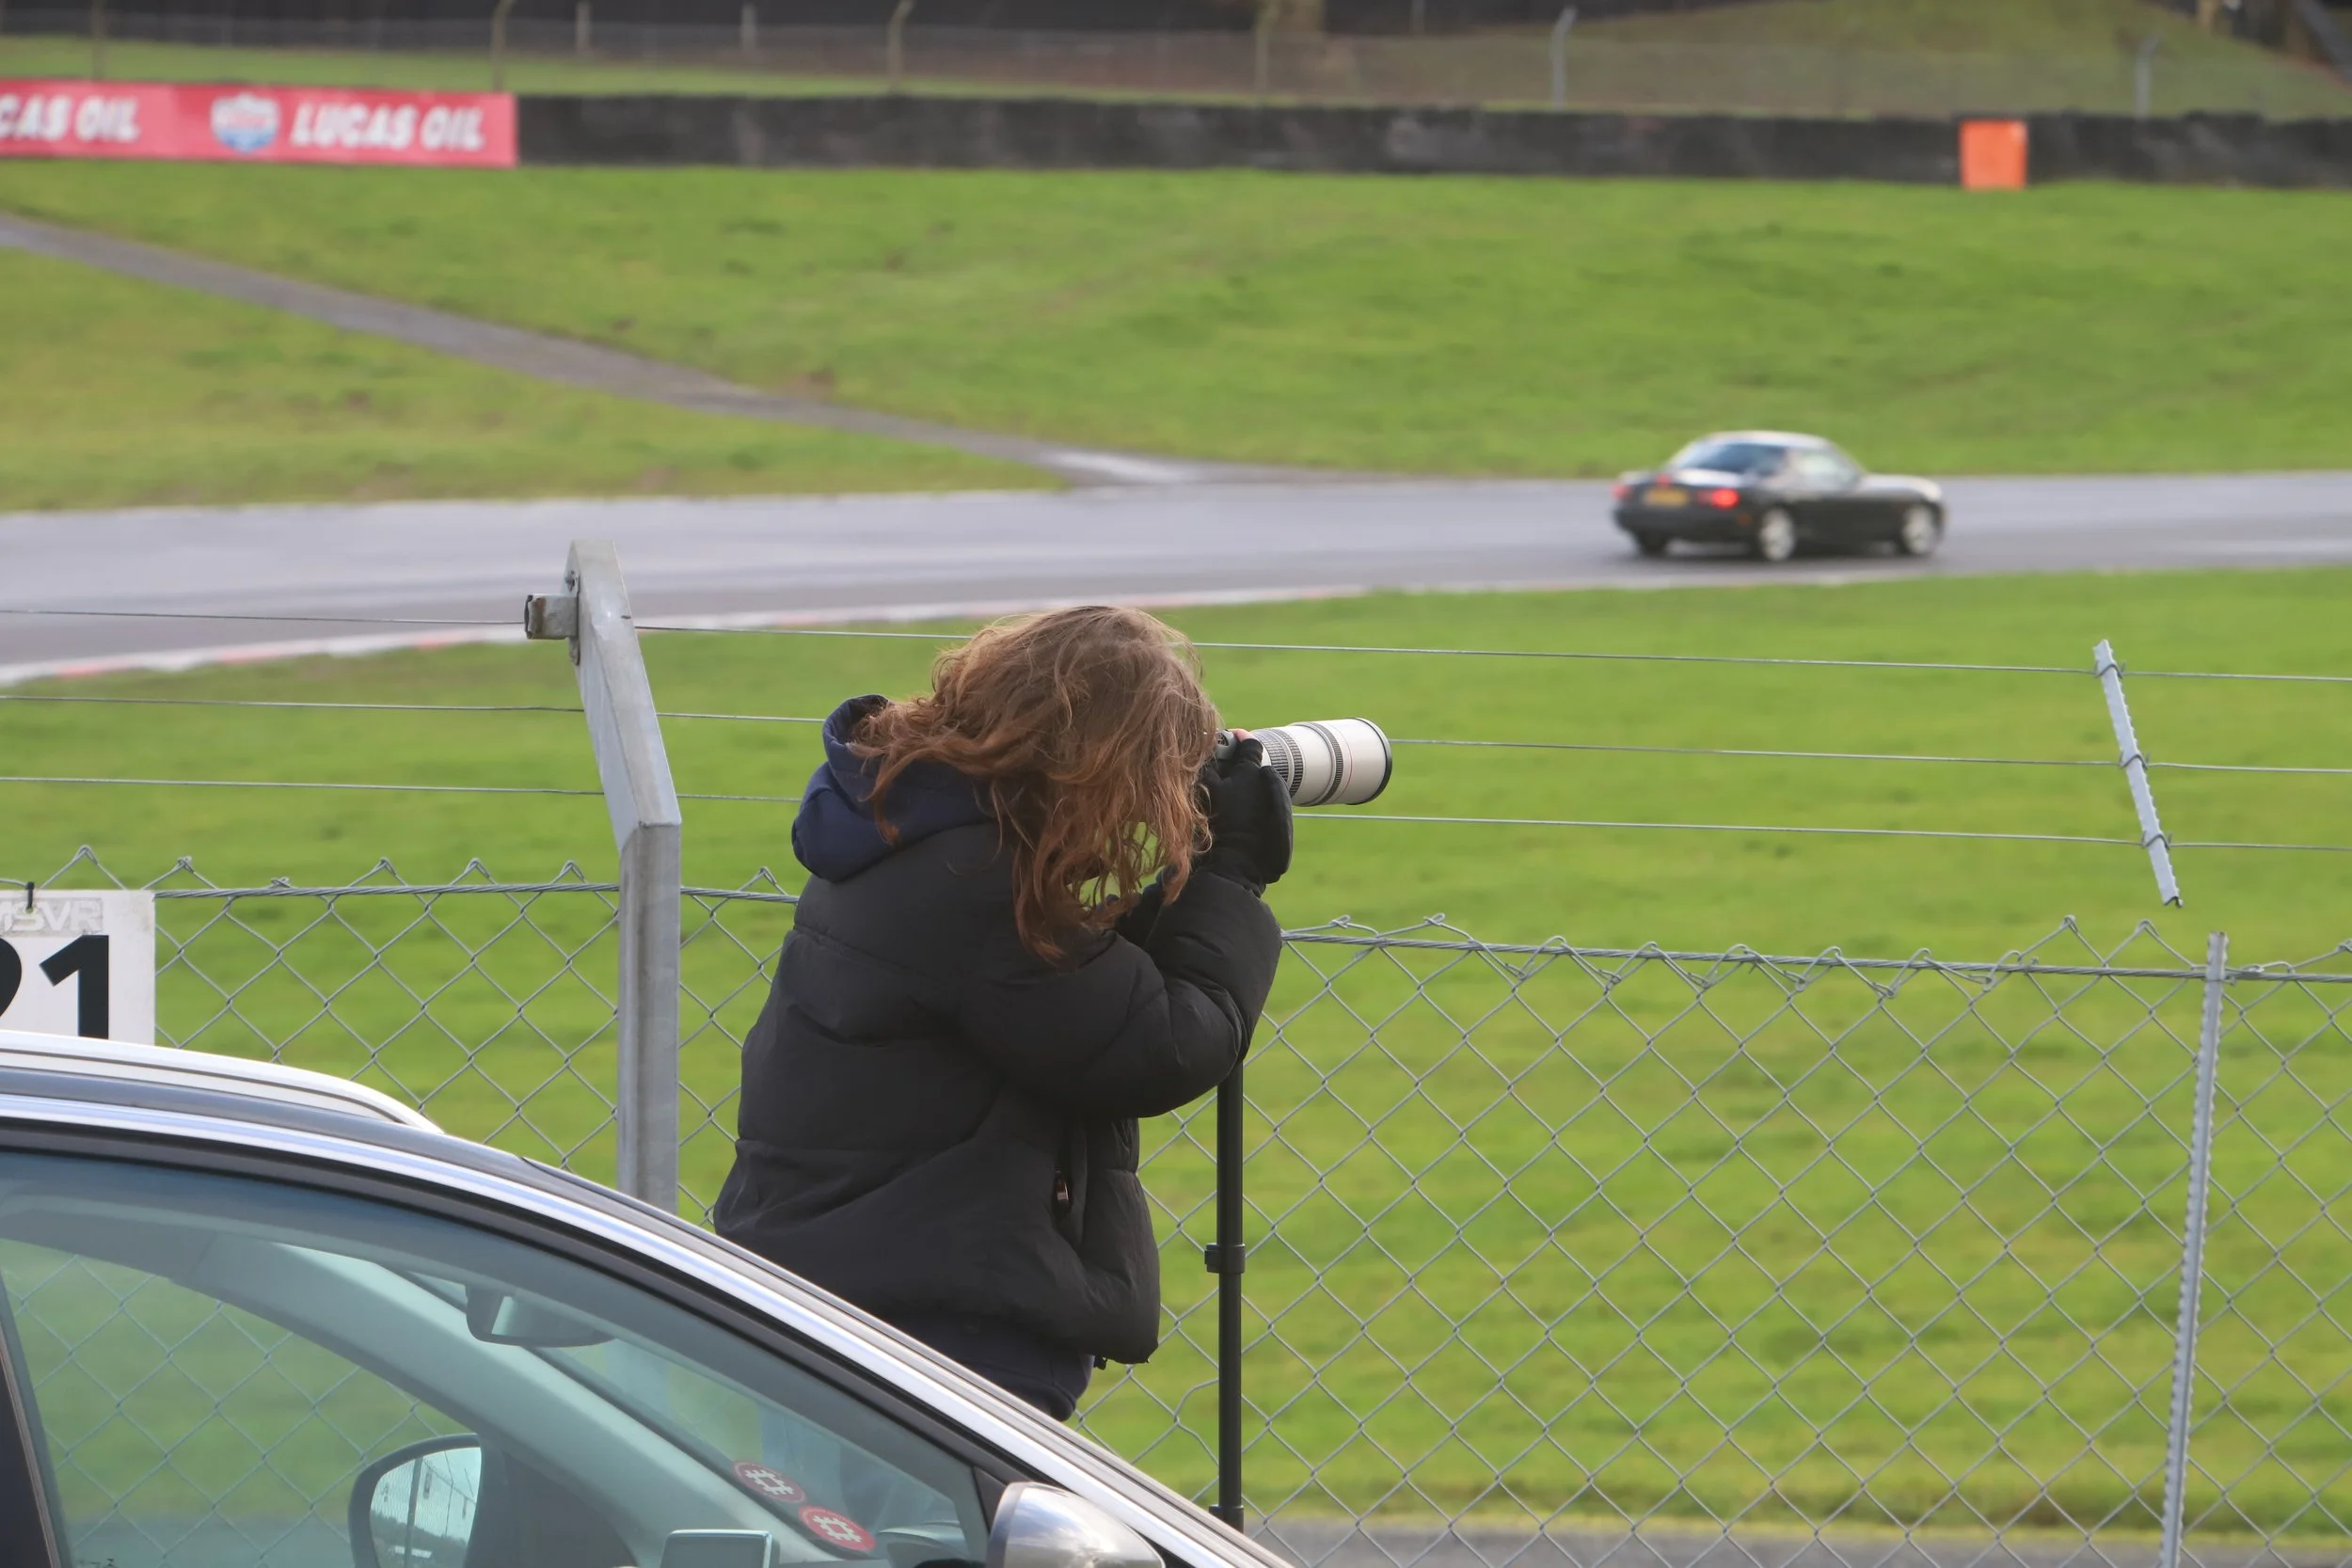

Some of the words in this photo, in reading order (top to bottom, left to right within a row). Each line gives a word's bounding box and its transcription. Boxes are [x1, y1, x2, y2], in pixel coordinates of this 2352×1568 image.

[76, 96, 141, 144] OIL
[292, 103, 416, 150] LUCAS
[421, 105, 484, 151] OIL
